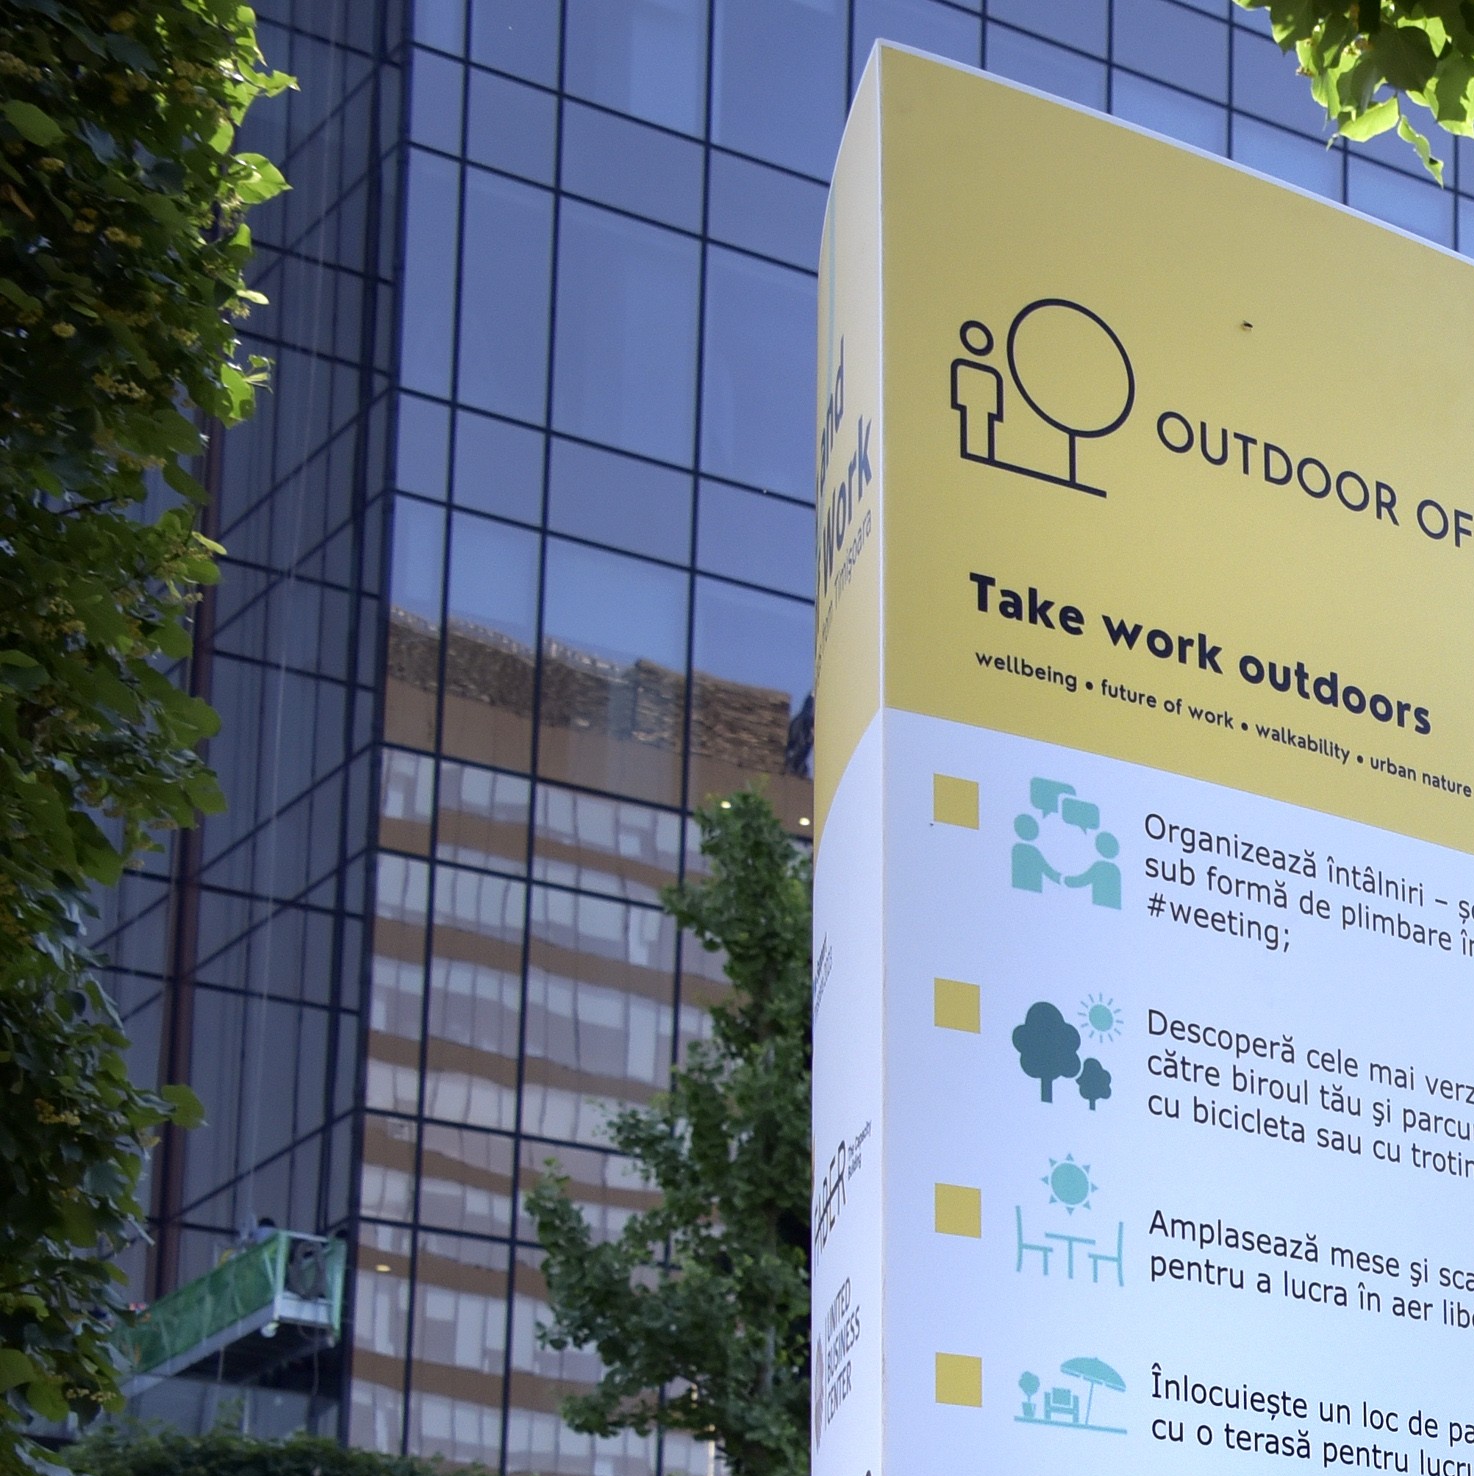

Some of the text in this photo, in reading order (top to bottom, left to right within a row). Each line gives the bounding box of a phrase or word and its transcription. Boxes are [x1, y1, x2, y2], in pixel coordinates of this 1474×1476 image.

[1156, 410, 1400, 527] OUTDOOR
[968, 571, 1432, 736] Take work outdoors
[974, 651, 1078, 694] wellbeing
[1100, 678, 1158, 709] future
[1163, 697, 1183, 716] of
[1187, 705, 1235, 731] work
[1254, 723, 1351, 766] walkability
[1369, 756, 1417, 782] urban
[1421, 772, 1473, 798] nature
[1144, 813, 1317, 879] Organizează
[1326, 855, 1424, 908] întâlniri
[1144, 857, 1196, 887] sub
[1206, 865, 1288, 910] formă
[1299, 889, 1331, 920] de
[1341, 902, 1452, 952] plimbare
[1146, 891, 1290, 954] #weeting;
[1147, 1008, 1295, 1065] Descoperă
[1306, 1048, 1359, 1078] cele
[1369, 1061, 1415, 1092] mai
[1147, 1047, 1221, 1088] către
[1232, 1063, 1309, 1106] biroul
[1319, 1082, 1362, 1118] tău
[1147, 1094, 1180, 1120] cu
[1193, 1095, 1306, 1144] bicicleta
[1316, 1127, 1362, 1156] sau
[1372, 1139, 1401, 1164] cu
[1148, 1209, 1319, 1264] Amplasează
[1330, 1246, 1400, 1278] mese
[827, 1277, 851, 1342] UNITED
[1150, 1254, 1245, 1290] pentru
[1256, 1272, 1272, 1295] a
[1283, 1269, 1348, 1308] lucra
[1357, 1281, 1381, 1313] în
[1391, 1296, 1434, 1322] aer
[827, 1305, 861, 1384] BUSINESS
[827, 1360, 852, 1425] CENTER
[1319, 1401, 1351, 1426] un
[1362, 1400, 1399, 1433] loc
[1408, 1409, 1439, 1439] de
[1151, 1418, 1184, 1443] cu
[1196, 1424, 1213, 1447] o
[1223, 1422, 1311, 1460] terasă
[1323, 1441, 1409, 1474] pentru
